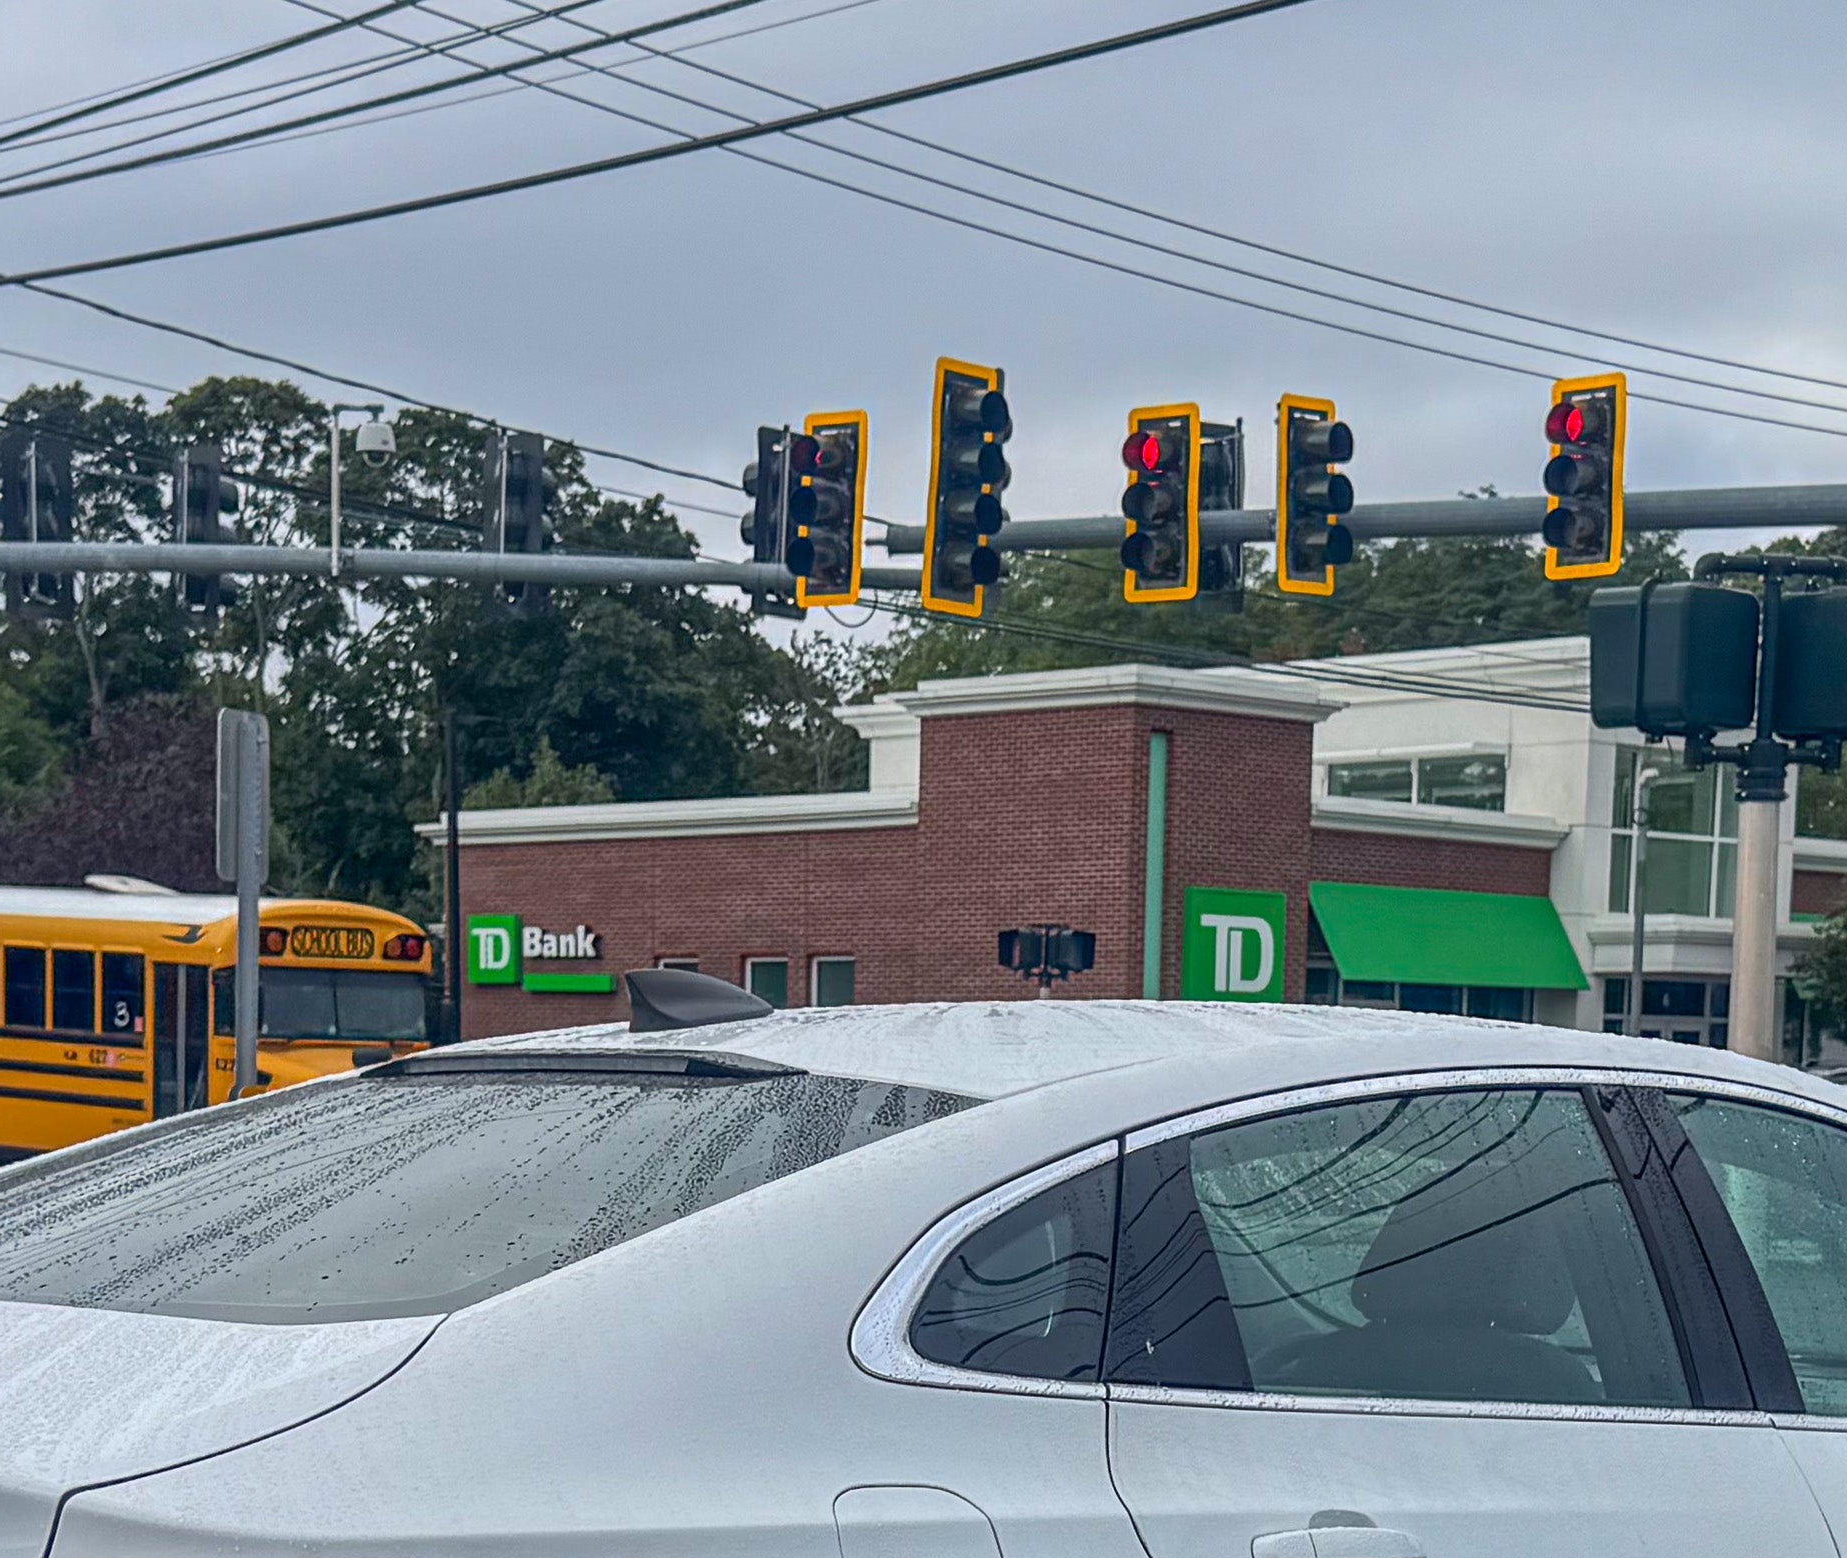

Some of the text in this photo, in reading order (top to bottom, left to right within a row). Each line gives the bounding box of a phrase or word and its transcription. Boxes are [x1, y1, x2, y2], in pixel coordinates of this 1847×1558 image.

[294, 928, 372, 956] SCHOOL BUS
[471, 924, 596, 970] TD Bank
[1200, 913, 1274, 993] TD
[114, 1000, 130, 1028] 3
